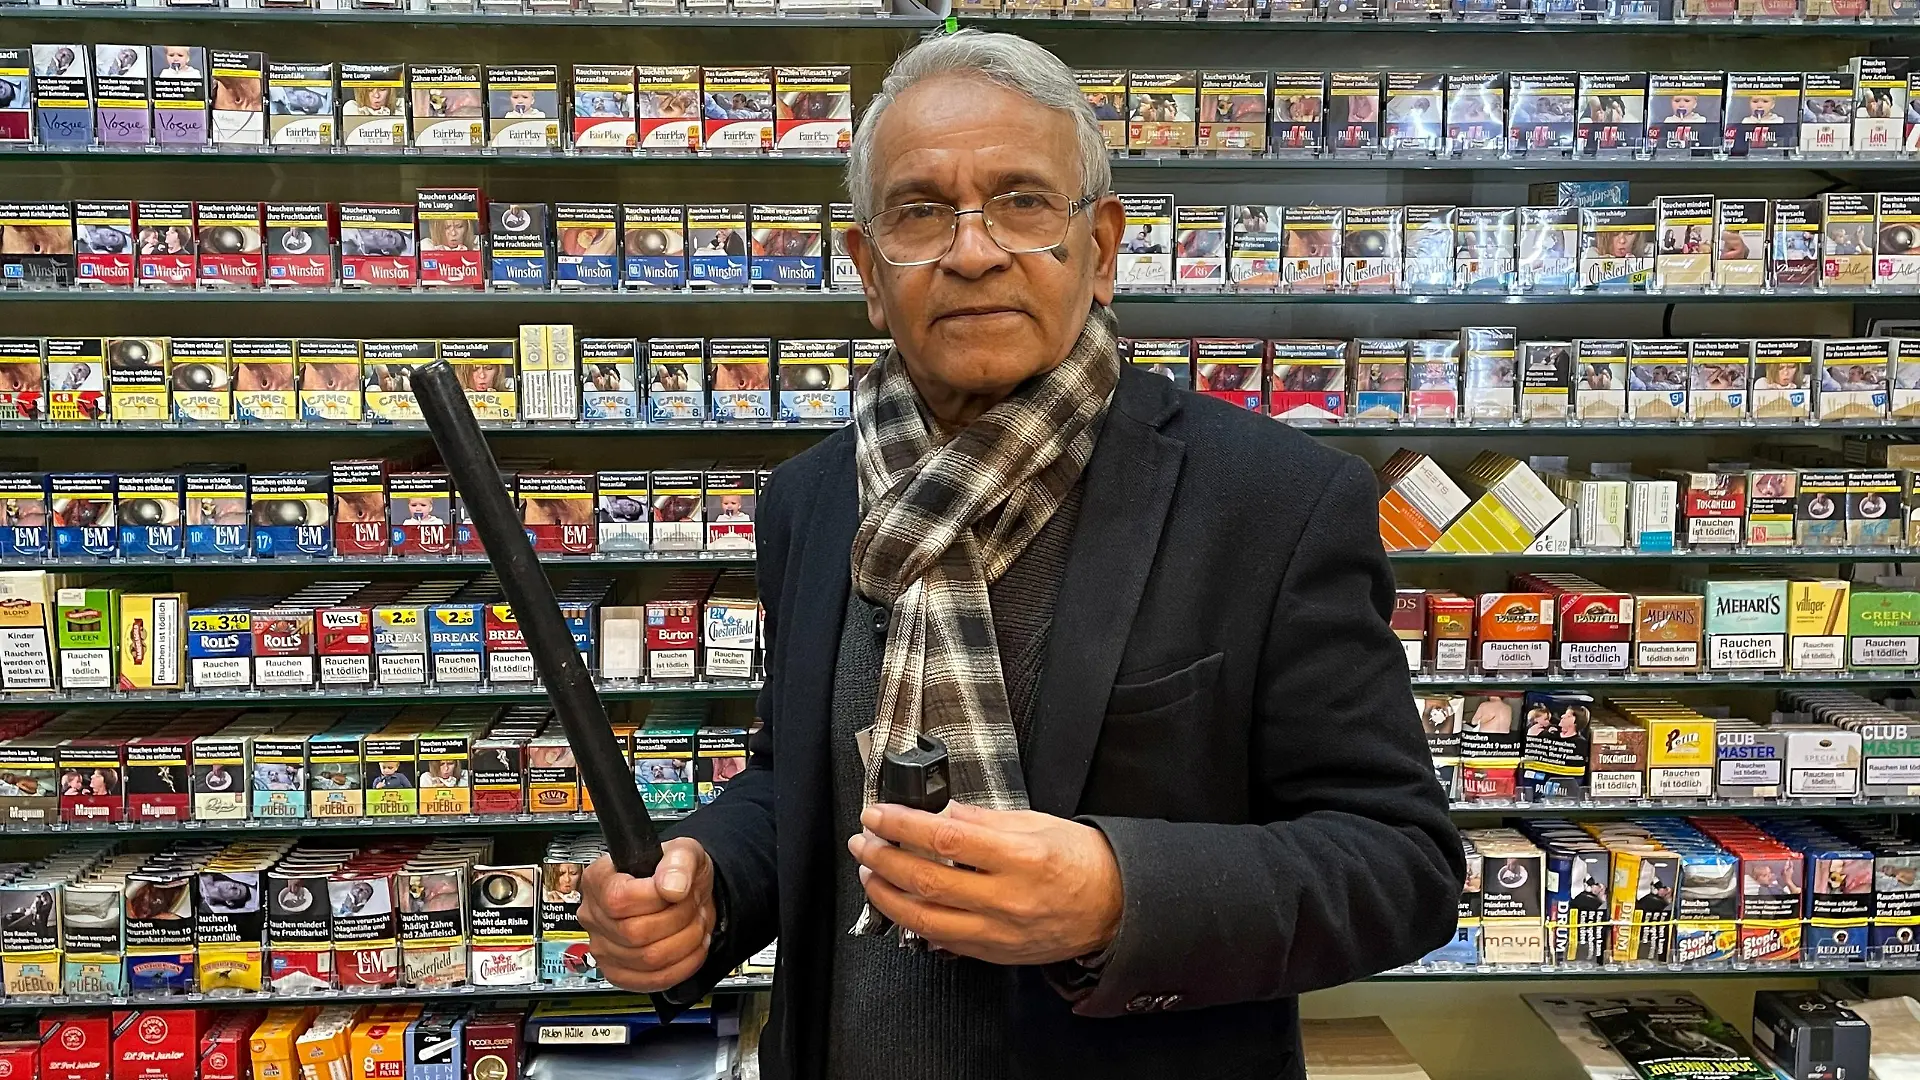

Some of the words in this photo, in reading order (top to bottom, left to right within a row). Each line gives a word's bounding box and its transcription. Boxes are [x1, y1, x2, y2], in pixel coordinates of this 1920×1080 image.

[43, 113, 86, 132] Vogue
[102, 113, 144, 130] Vogue
[159, 113, 202, 130] Vogue
[1816, 130, 1834, 144] Lord
[1870, 130, 1888, 144] Lord
[418, 193, 447, 202] Rauchen
[449, 193, 476, 203] schädigt
[418, 202, 432, 210] Ihre
[434, 202, 454, 212] Lunge
[92, 265, 130, 277] Winston
[288, 266, 324, 278] Winston
[372, 266, 409, 280] Winston
[439, 264, 478, 278] Winston
[577, 265, 612, 278] Winston
[779, 265, 816, 278] Winston
[837, 266, 860, 275] NI
[180, 396, 222, 406] CAMEL
[658, 396, 698, 406] CAMEL
[793, 396, 836, 406] CAMEL
[1610, 486, 1618, 524] HEETS
[1661, 486, 1669, 524] HEETS
[1696, 499, 1736, 510] TOSCANELLO
[1696, 519, 1734, 528] Rauchen
[420, 526, 444, 545] L&M
[564, 526, 587, 545] L&M
[1693, 528, 1705, 536] ist
[1706, 527, 1735, 537] tödlich
[84, 528, 109, 548] L&M
[298, 528, 324, 548] L&M
[1535, 540, 1543, 552] 6
[1716, 593, 1780, 618] MEHARI'S
[1796, 587, 1825, 615] villiger
[326, 614, 358, 625] West
[1862, 611, 1912, 621] GREEN
[192, 620, 208, 631] 23
[709, 620, 754, 642] Chesterfield
[376, 633, 422, 644] BREAK
[433, 633, 479, 643] BREAK
[659, 630, 694, 640] Burton
[201, 634, 240, 649] ROLL'S
[264, 634, 302, 648] ROLL'S
[1720, 638, 1772, 648] Rauchen
[1866, 639, 1906, 647] Rauchen
[1491, 643, 1530, 651] Rauchen
[1532, 643, 1542, 651] ist
[1570, 644, 1617, 653] Rauchen
[5, 650, 44, 658] Rauchern
[68, 652, 104, 660] Rauchen
[1501, 653, 1532, 662] tödlich
[1719, 650, 1732, 660] ist
[1736, 649, 1776, 660] tödlich
[1877, 649, 1908, 657] tödlich
[35, 658, 46, 666] oft
[80, 660, 91, 668] ist
[158, 645, 166, 682] Rauchen
[326, 658, 365, 666] Rauchen
[382, 657, 420, 665] Rauchen
[1569, 654, 1583, 663] ist
[1584, 654, 1621, 664] tödlich
[72, 667, 100, 675] tödlich
[323, 667, 334, 676] ist
[336, 666, 368, 676] tödlich
[381, 667, 392, 675] ist
[393, 666, 423, 676] tödlich
[437, 666, 448, 674] ist
[450, 665, 479, 674] tödlich
[492, 664, 503, 673] ist
[504, 664, 533, 673] tödlich
[201, 670, 212, 678] ist
[214, 670, 242, 679] tödlich
[1462, 733, 1489, 742] Rauchen
[1863, 725, 1908, 740] CLUB
[1717, 734, 1755, 746] CLUB
[1718, 746, 1776, 759] MASTER
[1863, 741, 1920, 756] MASTE
[1598, 754, 1637, 766] TOSCANELLO
[1595, 782, 1606, 790] ist
[1607, 782, 1637, 790] tödlich
[541, 792, 566, 800] REVAL
[75, 804, 110, 819] Magnum
[142, 804, 176, 818] Magnum
[320, 803, 354, 816] PUEBLO
[374, 802, 409, 814] PUEBLO
[427, 801, 462, 813] PUEBLO
[473, 910, 500, 918] Rauchen
[1484, 909, 1526, 917] Fruchtbarkeit
[297, 920, 326, 929] mindert
[473, 919, 494, 927] erhöht
[1556, 900, 1569, 954] DRUM
[281, 928, 329, 938] Fruchtbarkeit
[1679, 931, 1713, 952] Stopf-
[1743, 930, 1778, 949] Stopf-
[1679, 944, 1716, 963] Beutel
[1743, 943, 1781, 960] Beutel
[1817, 945, 1839, 955] RED
[1839, 945, 1862, 954] BULL
[405, 951, 452, 982] Chesterfield
[10, 976, 54, 994] PUEBLO
[564, 1027, 584, 1038] Hülle
[364, 1057, 375, 1073] 8
